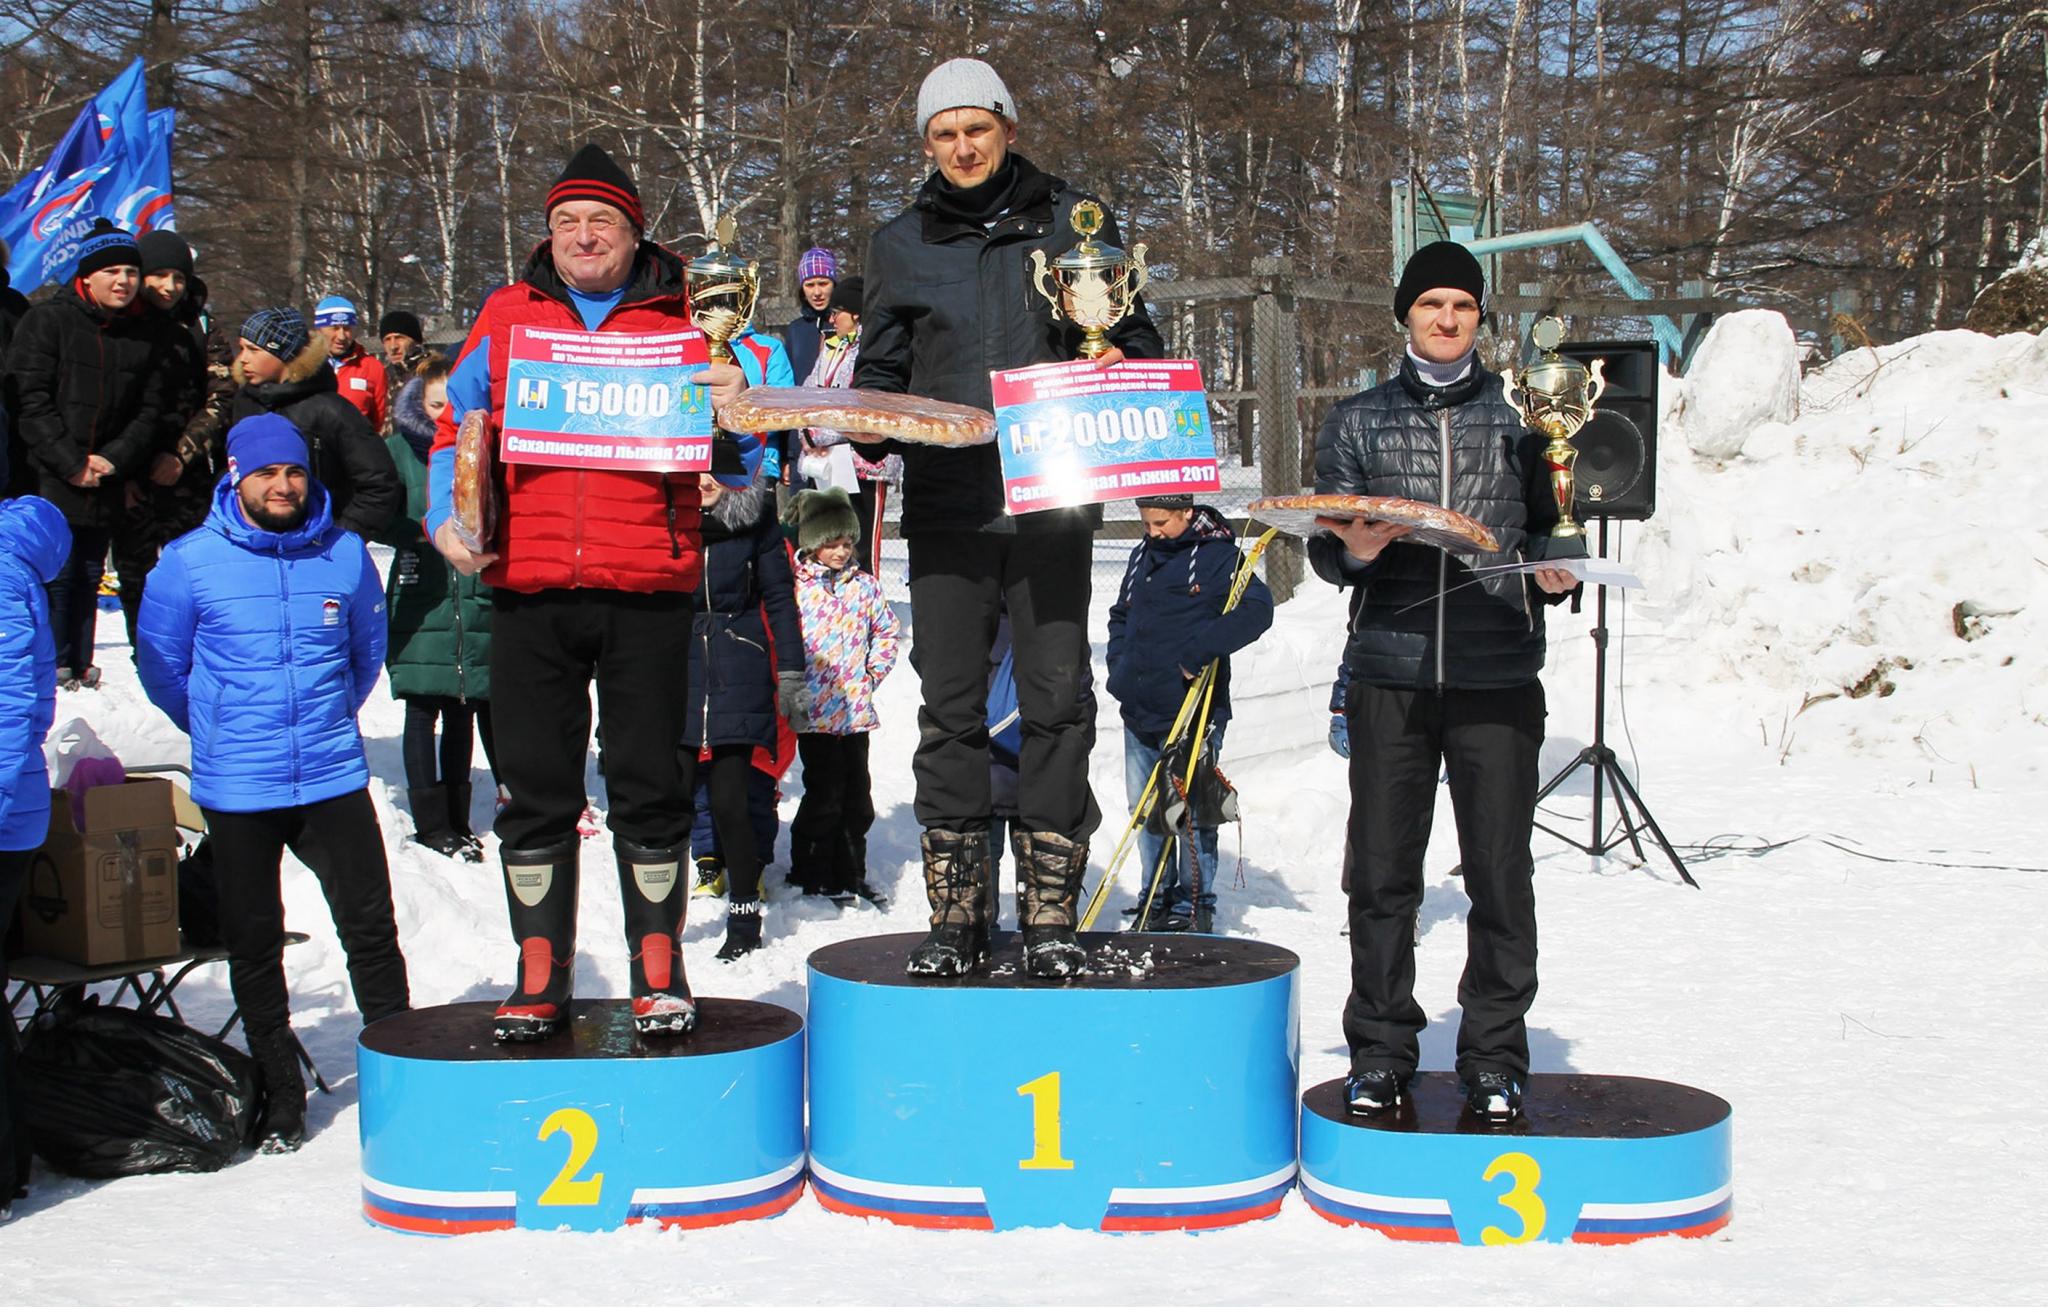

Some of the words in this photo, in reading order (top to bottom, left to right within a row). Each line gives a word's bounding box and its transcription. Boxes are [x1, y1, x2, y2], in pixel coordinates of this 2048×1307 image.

[561, 380, 670, 417] 15000
[1051, 406, 1168, 448] 20000
[507, 436, 612, 458] Сахалинская
[614, 444, 673, 460] лыжня
[675, 444, 709, 461] 2017
[1120, 469, 1179, 487] лыжня
[1181, 465, 1215, 482] 2017
[1018, 1072, 1074, 1169] 1
[538, 1108, 604, 1206] 2
[1481, 1152, 1546, 1246] 3
